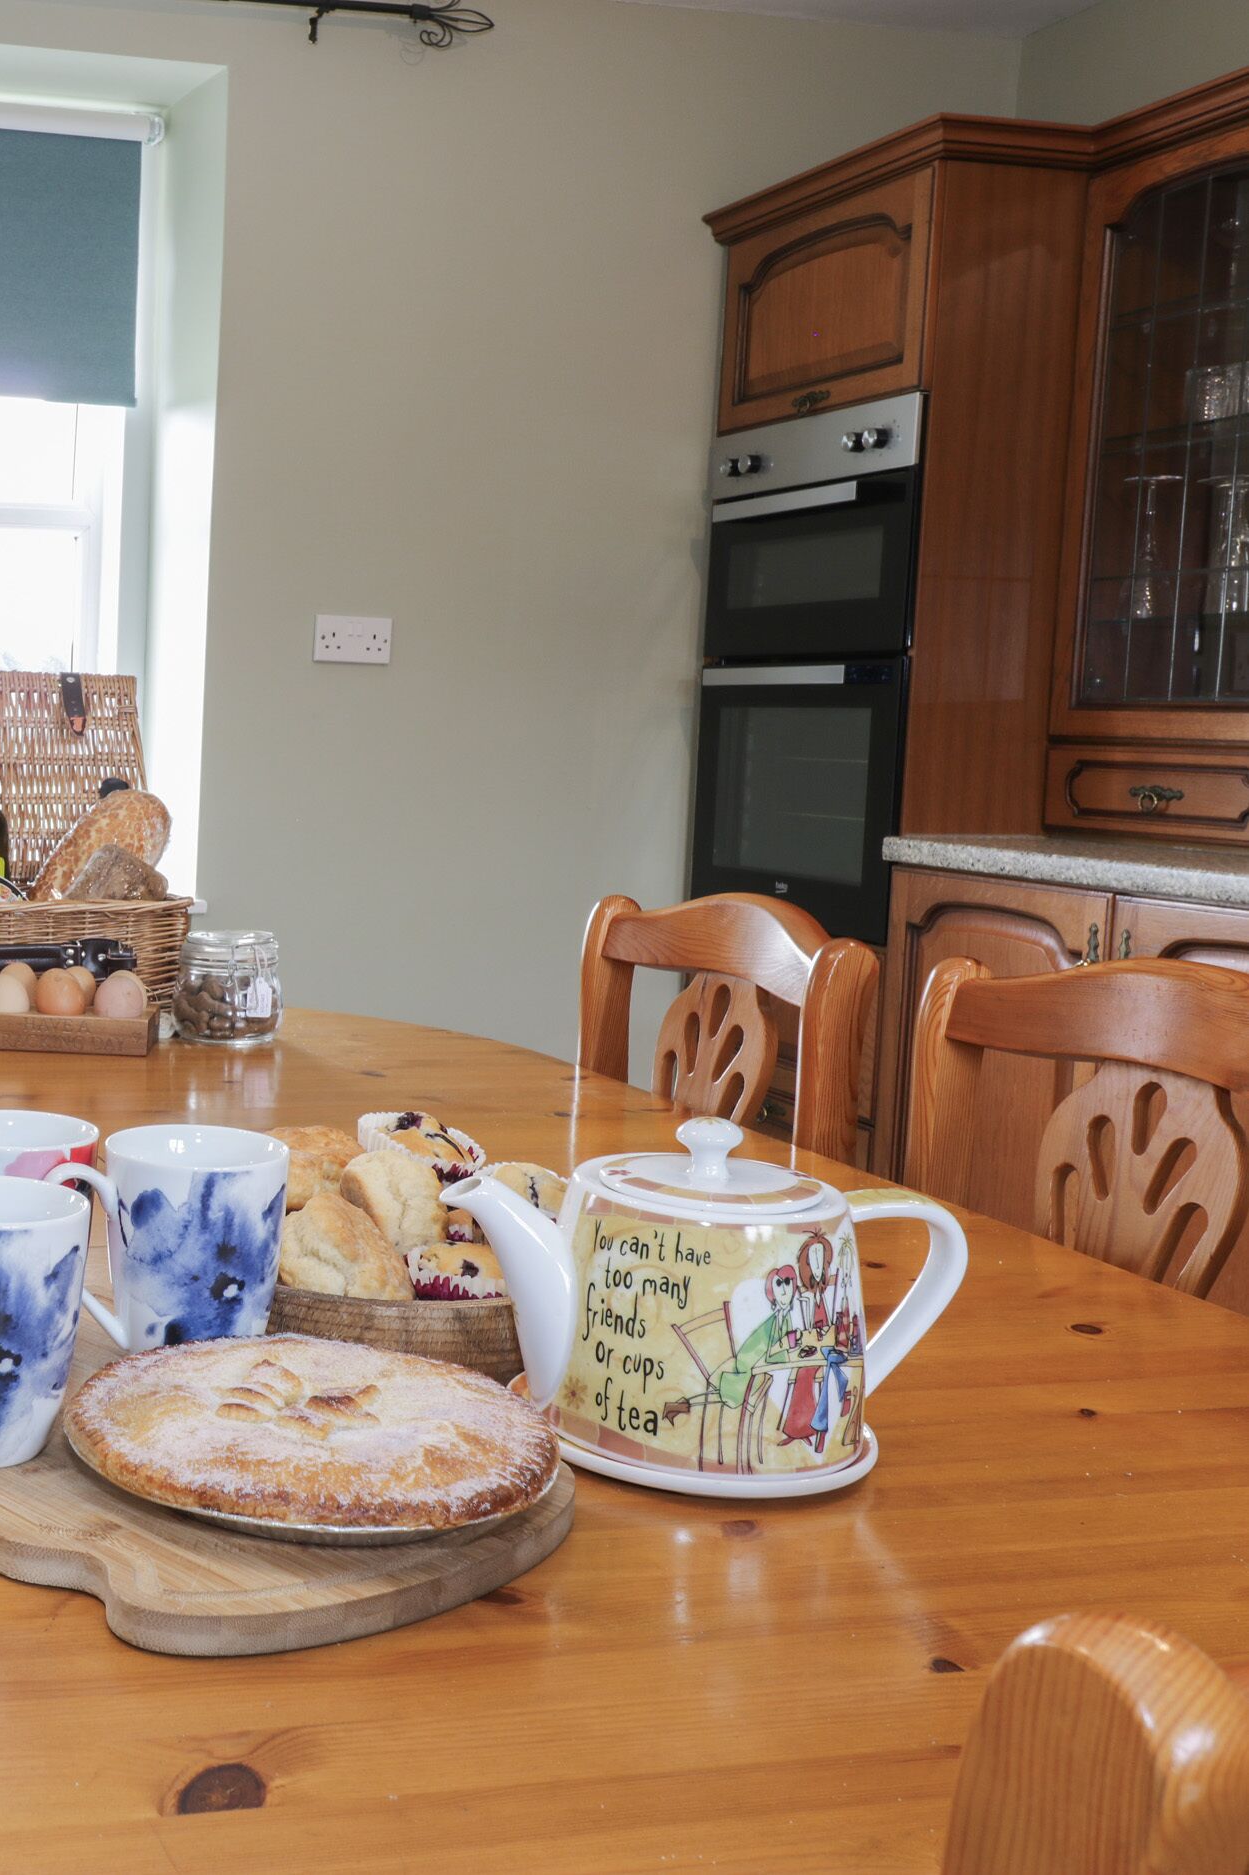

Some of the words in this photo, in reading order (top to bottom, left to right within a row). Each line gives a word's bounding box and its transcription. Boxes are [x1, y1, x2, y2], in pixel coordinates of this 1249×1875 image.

[23, 1016, 74, 1034] HAVE
[593, 1218, 614, 1253] You
[620, 1228, 666, 1262] can't
[674, 1231, 712, 1267] have
[604, 1257, 633, 1289] too
[642, 1275, 692, 1310] many
[582, 1281, 646, 1342] friends
[595, 1340, 615, 1369] or
[623, 1353, 665, 1394] cups
[595, 1376, 613, 1421] of
[617, 1390, 659, 1437] tea
